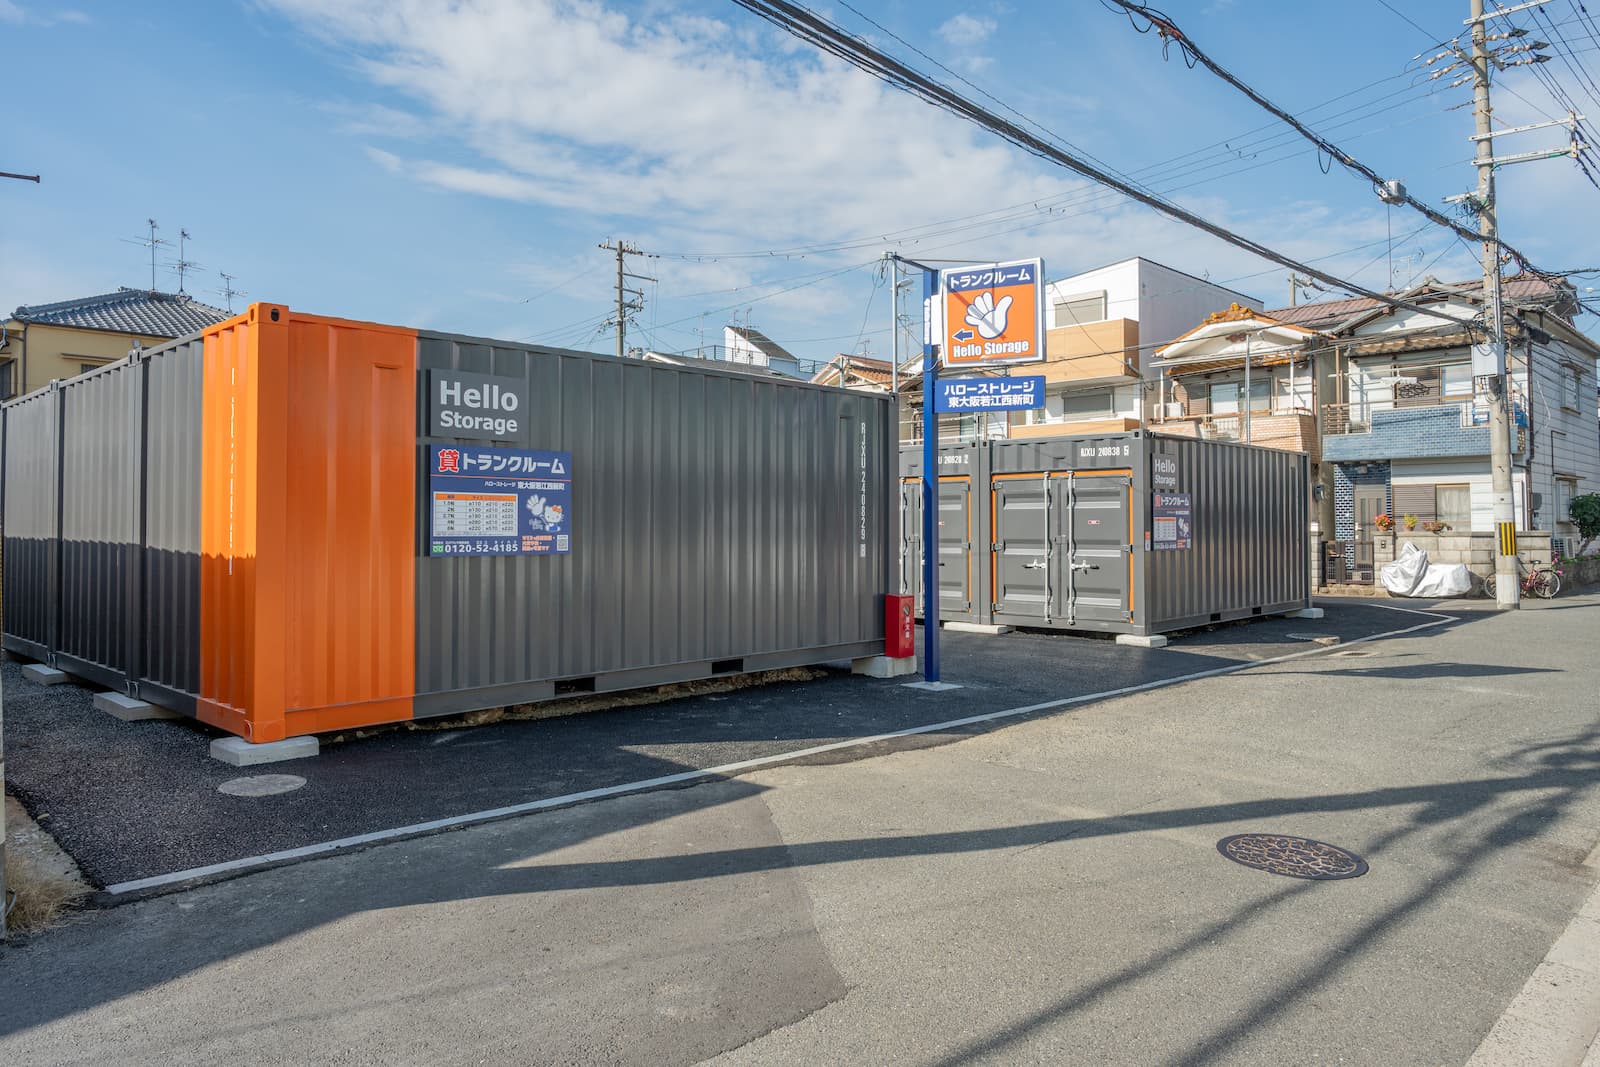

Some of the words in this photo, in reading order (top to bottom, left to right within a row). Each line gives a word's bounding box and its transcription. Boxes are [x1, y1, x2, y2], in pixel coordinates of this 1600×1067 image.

[950, 268, 1031, 289] トランクルーム
[953, 343, 982, 358] Hello
[984, 341, 1030, 355] Storage
[440, 380, 519, 412] Hello
[944, 380, 1035, 396] ハローストレージ
[948, 394, 1034, 408] 東大阪若江西新町
[440, 410, 518, 435] Storage
[1154, 459, 1176, 473] Hello
[1154, 475, 1176, 486] Storage
[444, 544, 518, 553] 0120-52-4185
